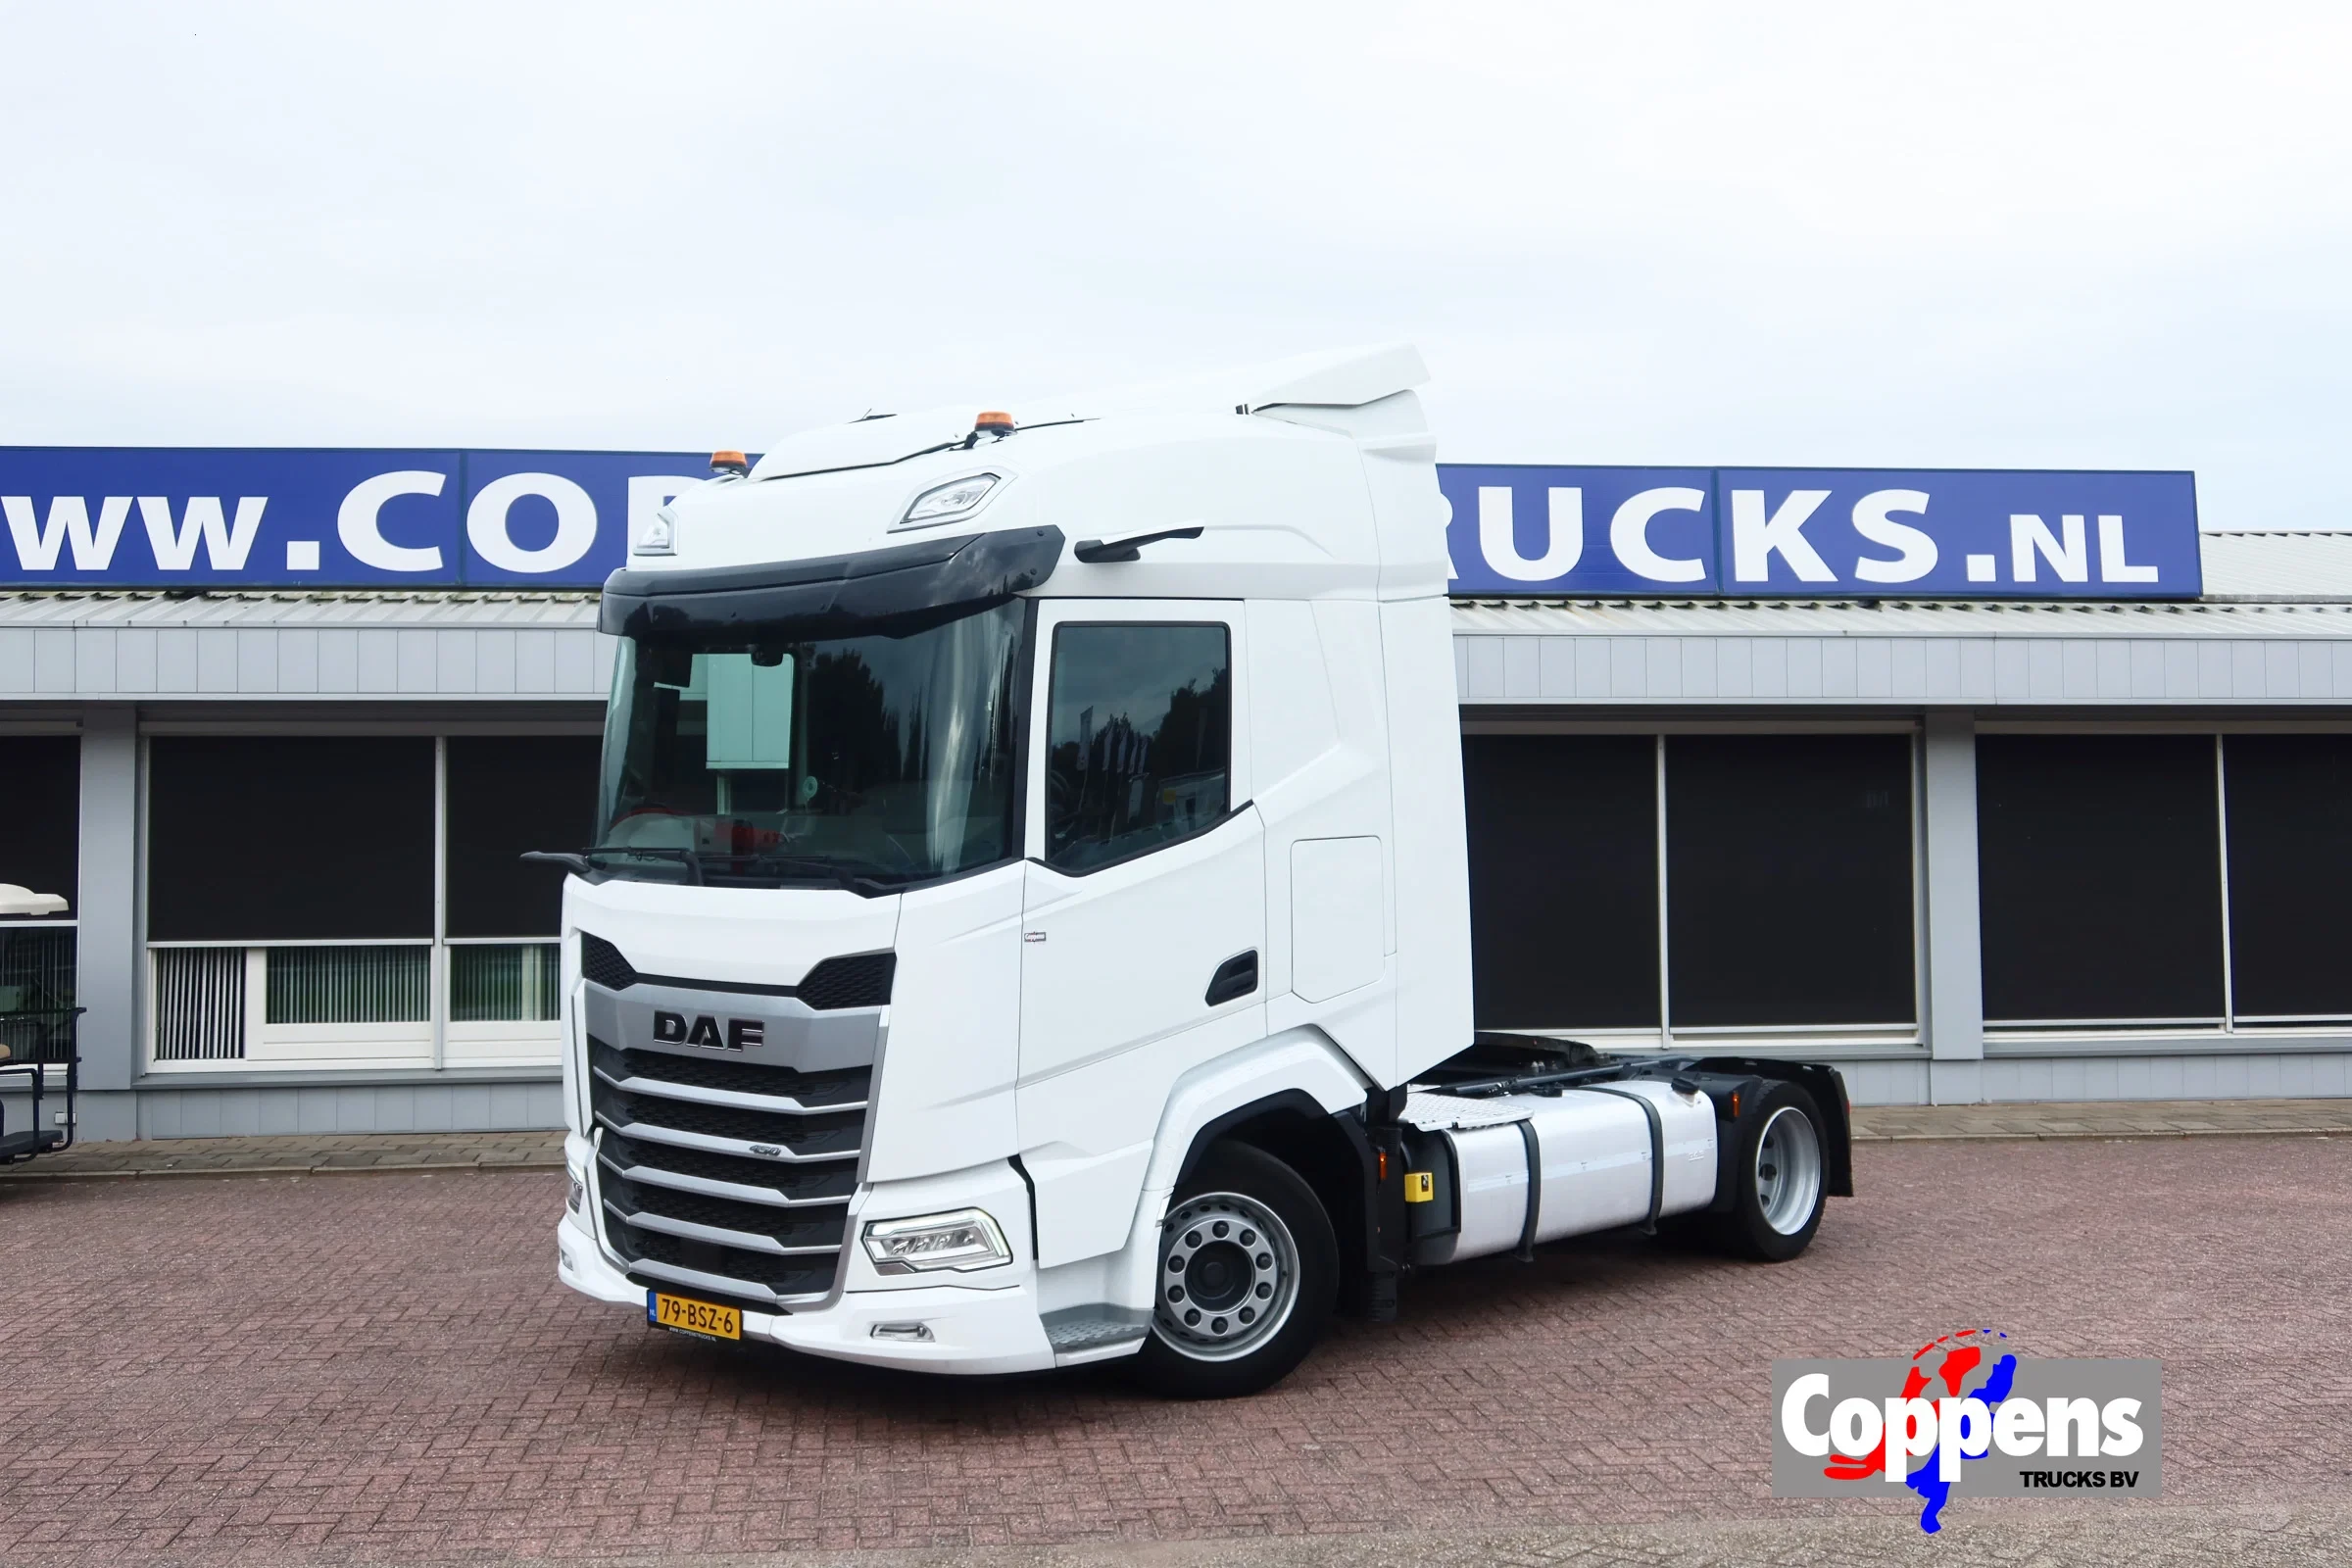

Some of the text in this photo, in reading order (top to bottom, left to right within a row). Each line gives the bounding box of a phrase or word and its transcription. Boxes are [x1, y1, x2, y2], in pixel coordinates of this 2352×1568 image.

[1442, 484, 2159, 584] UCKS.NL
[653, 1009, 765, 1053] DAF
[662, 1298, 734, 1334] 79-BSZ-6
